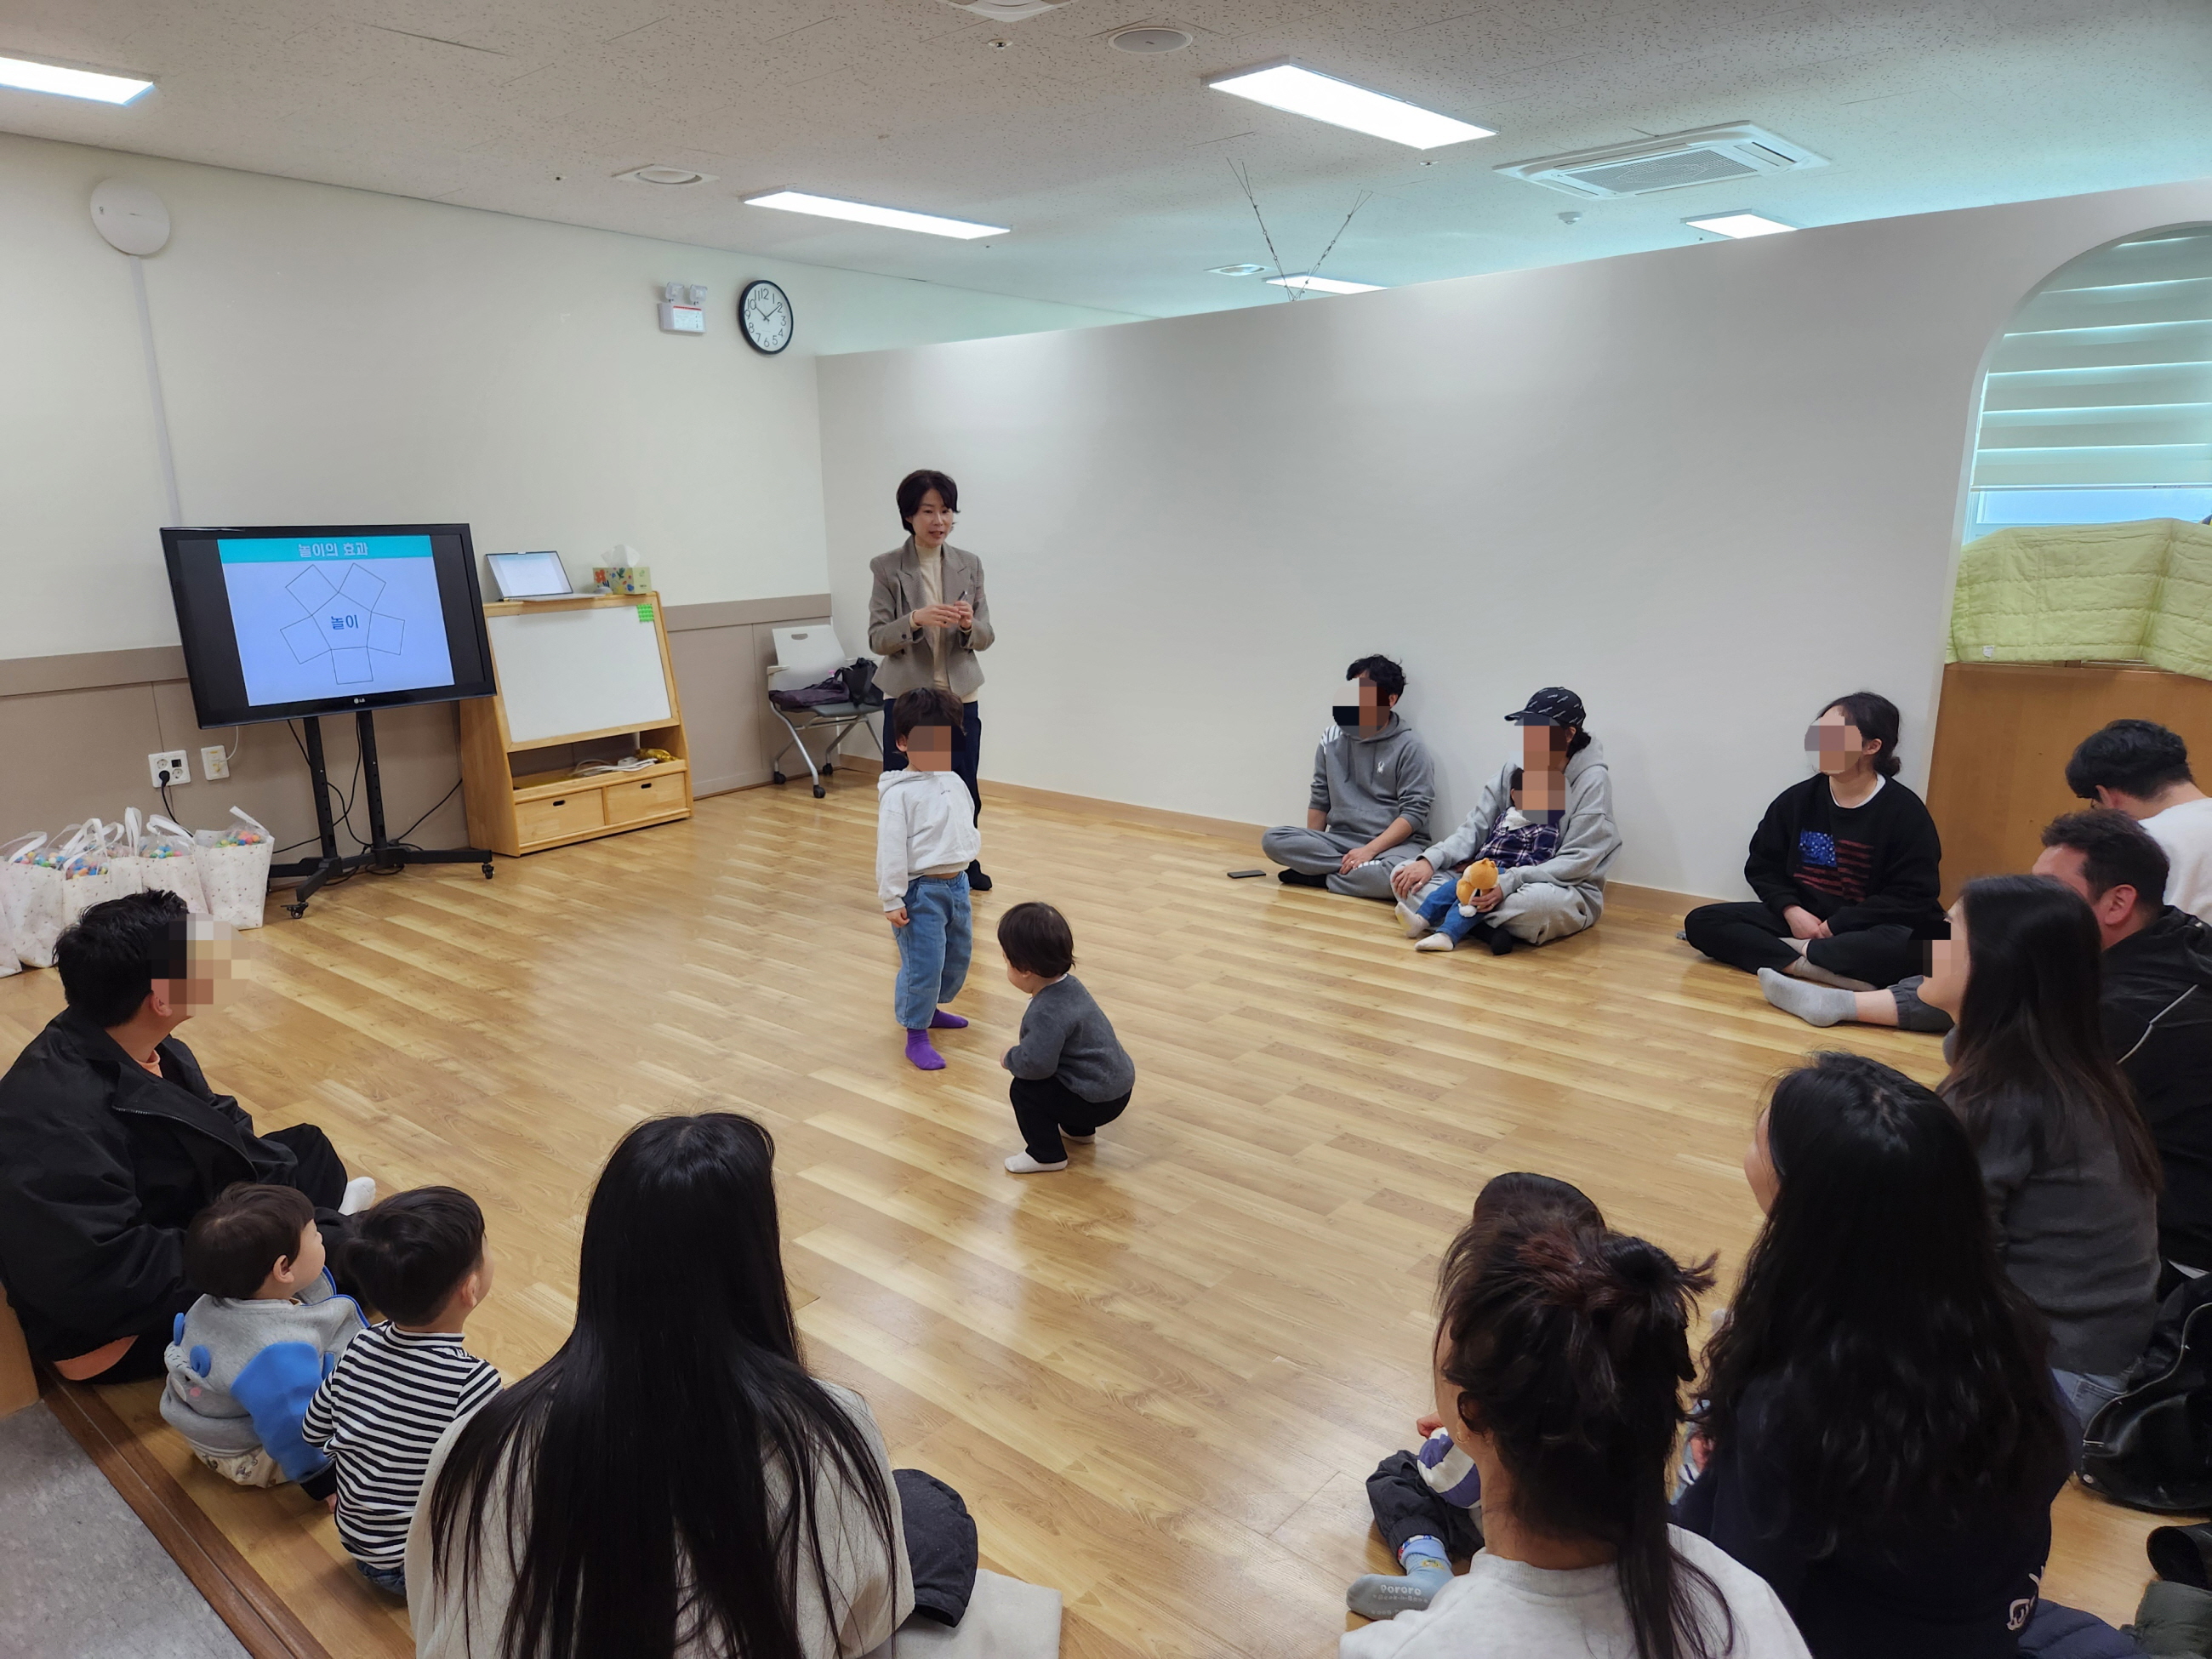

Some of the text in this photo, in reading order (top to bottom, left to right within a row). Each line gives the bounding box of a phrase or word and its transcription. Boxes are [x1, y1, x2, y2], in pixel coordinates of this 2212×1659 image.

[754, 289, 761, 301] 11
[761, 288, 769, 299] 12
[747, 299, 756, 311] 10
[777, 301, 783, 313] 2
[744, 309, 751, 320] 9
[780, 316, 787, 326] 3
[749, 322, 755, 334] 8
[778, 328, 784, 338] 4
[755, 332, 761, 343] 7
[763, 337, 770, 348] 6
[772, 335, 778, 345] 5
[298, 542, 369, 558] 놀이의 효과
[331, 614, 359, 630] 놀이
